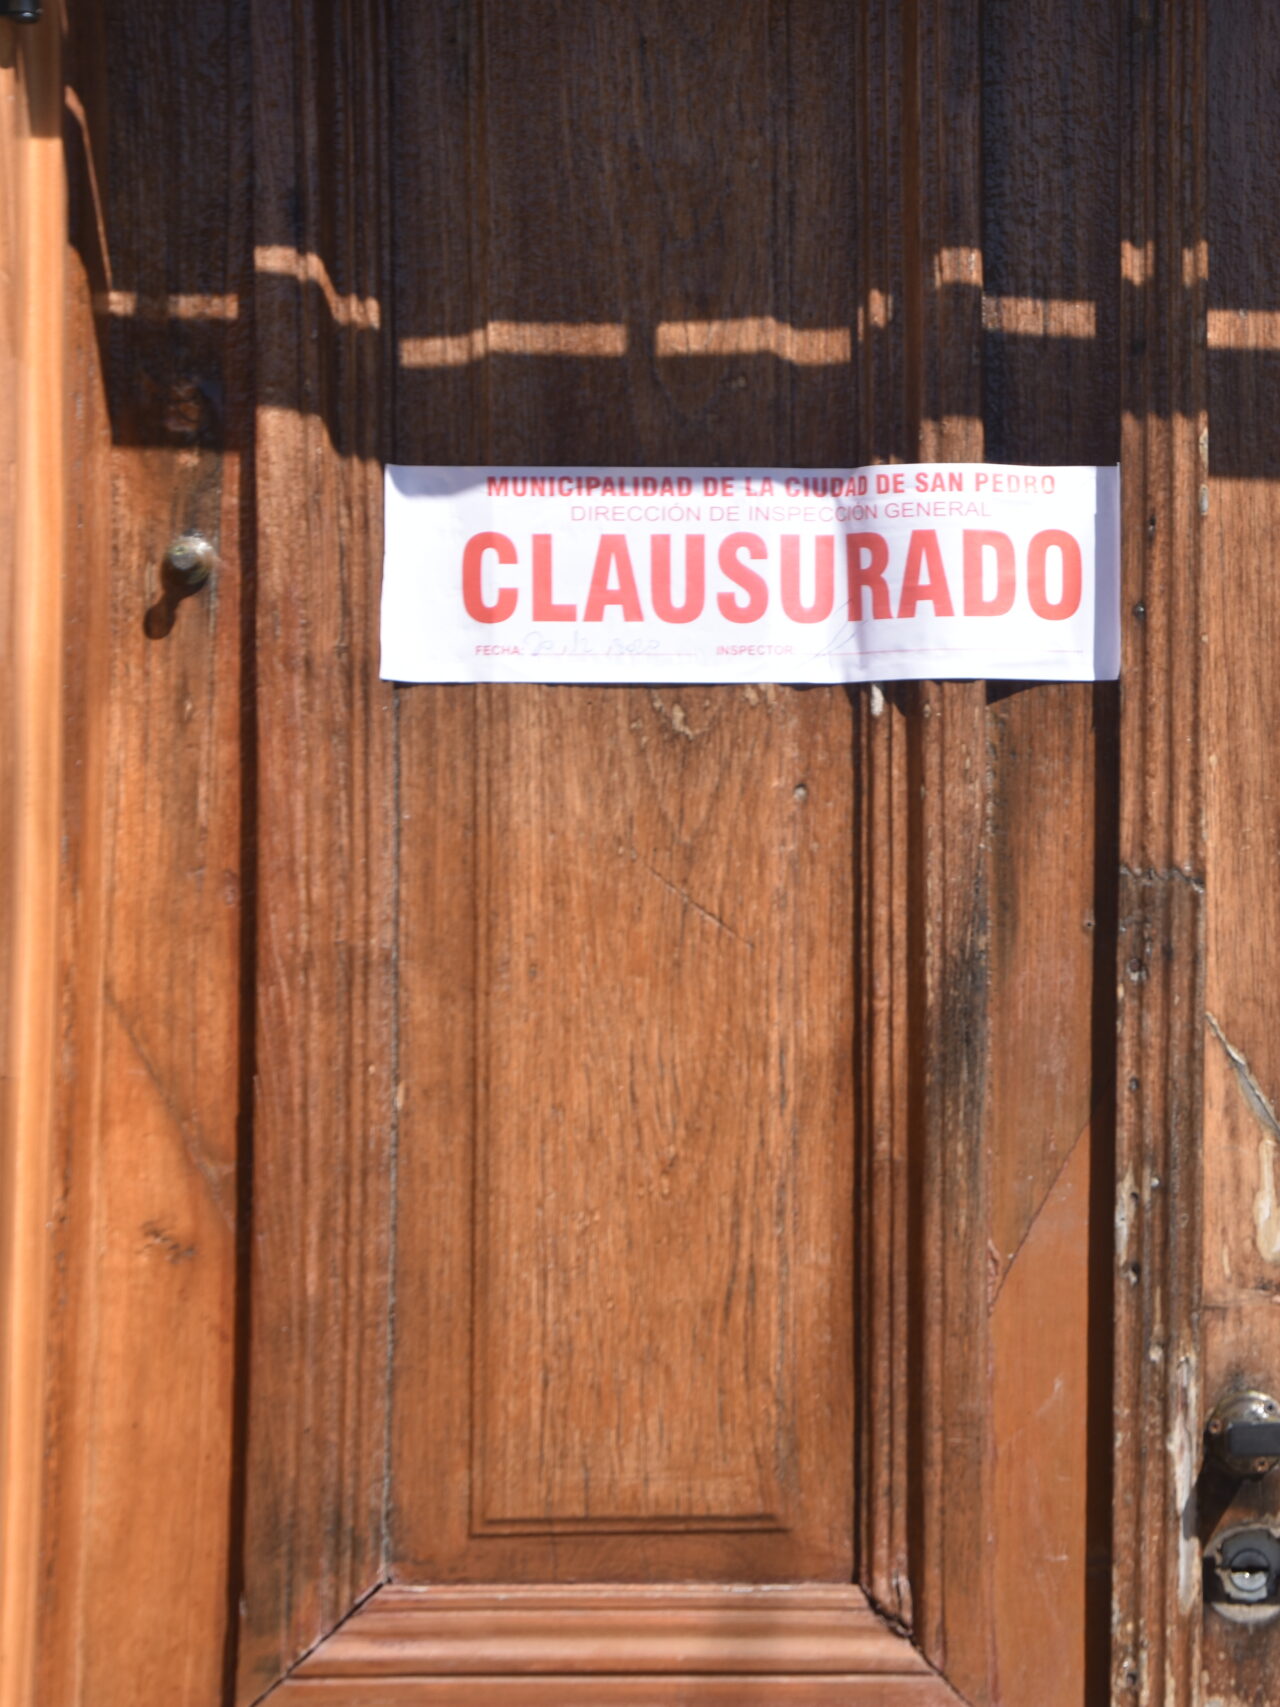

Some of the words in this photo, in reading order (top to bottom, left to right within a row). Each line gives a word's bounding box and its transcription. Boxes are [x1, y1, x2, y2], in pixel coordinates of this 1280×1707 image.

[487, 476, 693, 497] MUNICIPALIDAD
[703, 476, 735, 497] DE
[745, 476, 774, 497] LA
[785, 475, 867, 497] CIUDAD
[876, 473, 905, 495] DE
[915, 472, 963, 493] SAN
[975, 472, 1056, 494] PEDRO
[571, 502, 701, 522] DIRECCIÓN
[710, 505, 740, 521] DE
[748, 501, 877, 522] INSPECCIÓN
[884, 501, 992, 519] GENERAL
[461, 528, 1083, 624] CLAUSURADO
